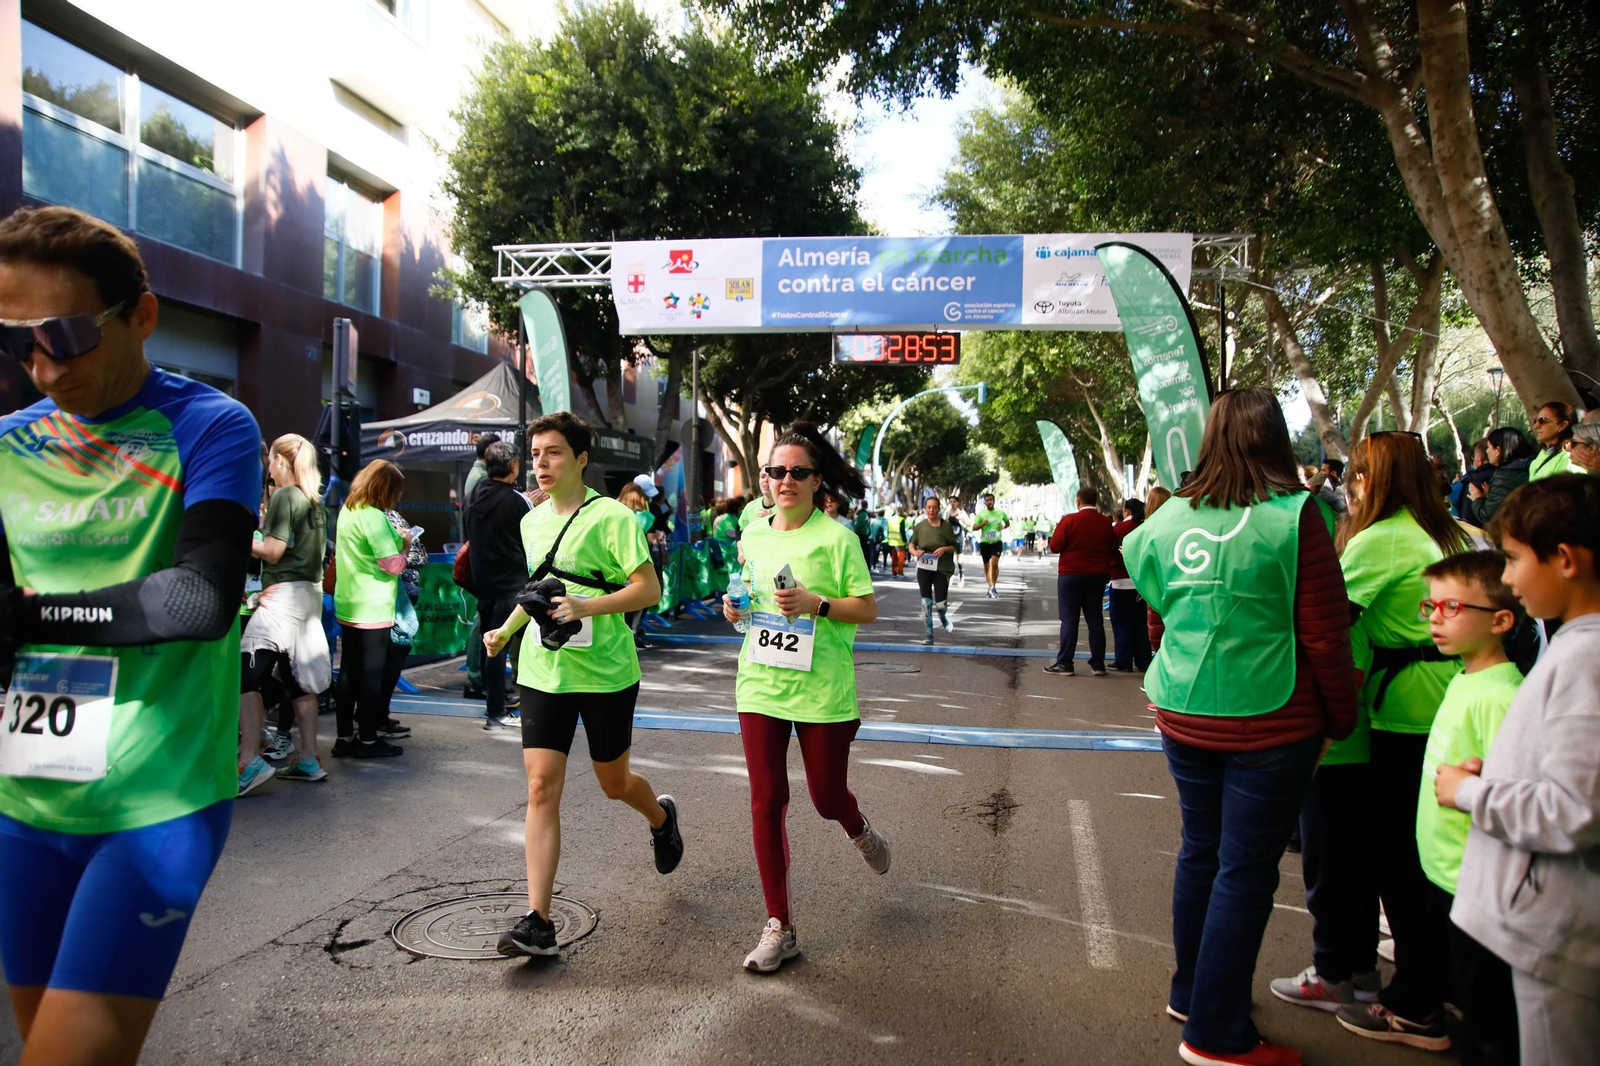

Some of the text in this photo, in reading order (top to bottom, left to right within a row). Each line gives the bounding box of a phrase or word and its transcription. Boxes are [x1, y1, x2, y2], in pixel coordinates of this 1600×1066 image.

[778, 245, 1008, 267] Almería en marcha
[1054, 247, 1099, 260] cajama
[778, 272, 976, 293] contra el cáncer
[771, 311, 849, 319] #TodosContraElCáncer
[95, 531, 129, 545] Seed
[41, 606, 113, 623] KIPRUN
[758, 629, 799, 653] 842
[8, 693, 77, 737] 320
